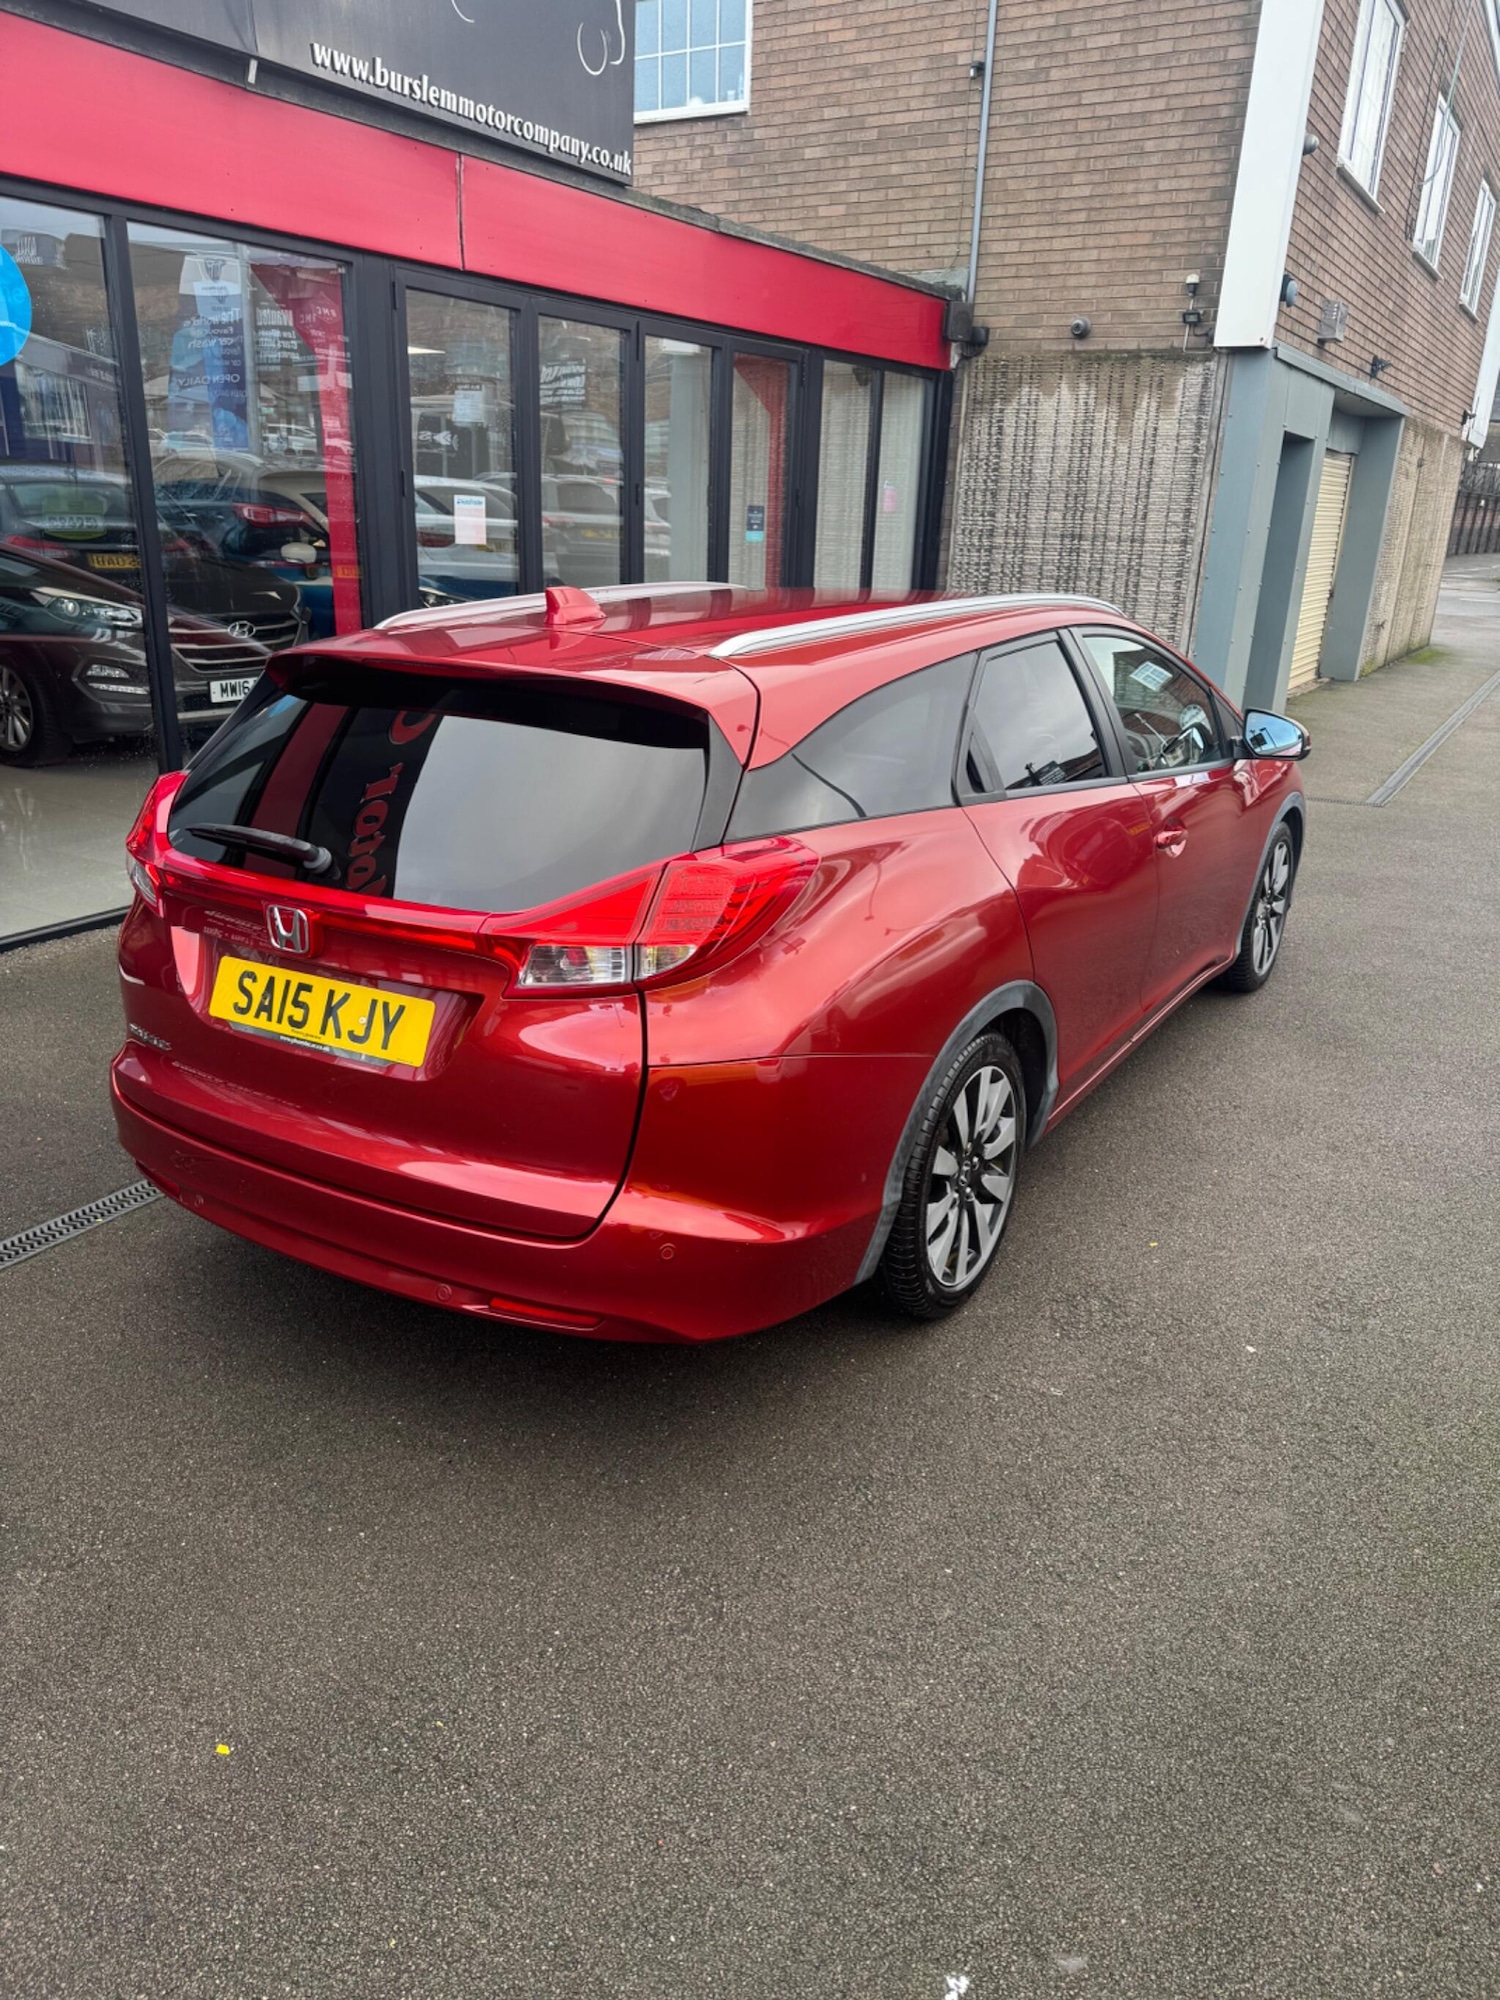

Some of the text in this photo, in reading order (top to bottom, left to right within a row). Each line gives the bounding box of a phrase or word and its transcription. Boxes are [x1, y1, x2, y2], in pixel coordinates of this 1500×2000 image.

[310, 42, 632, 176] www.burslemmotorcompany.co.uk
[219, 680, 250, 698] MW16
[233, 970, 406, 1050] SA15 KJY
